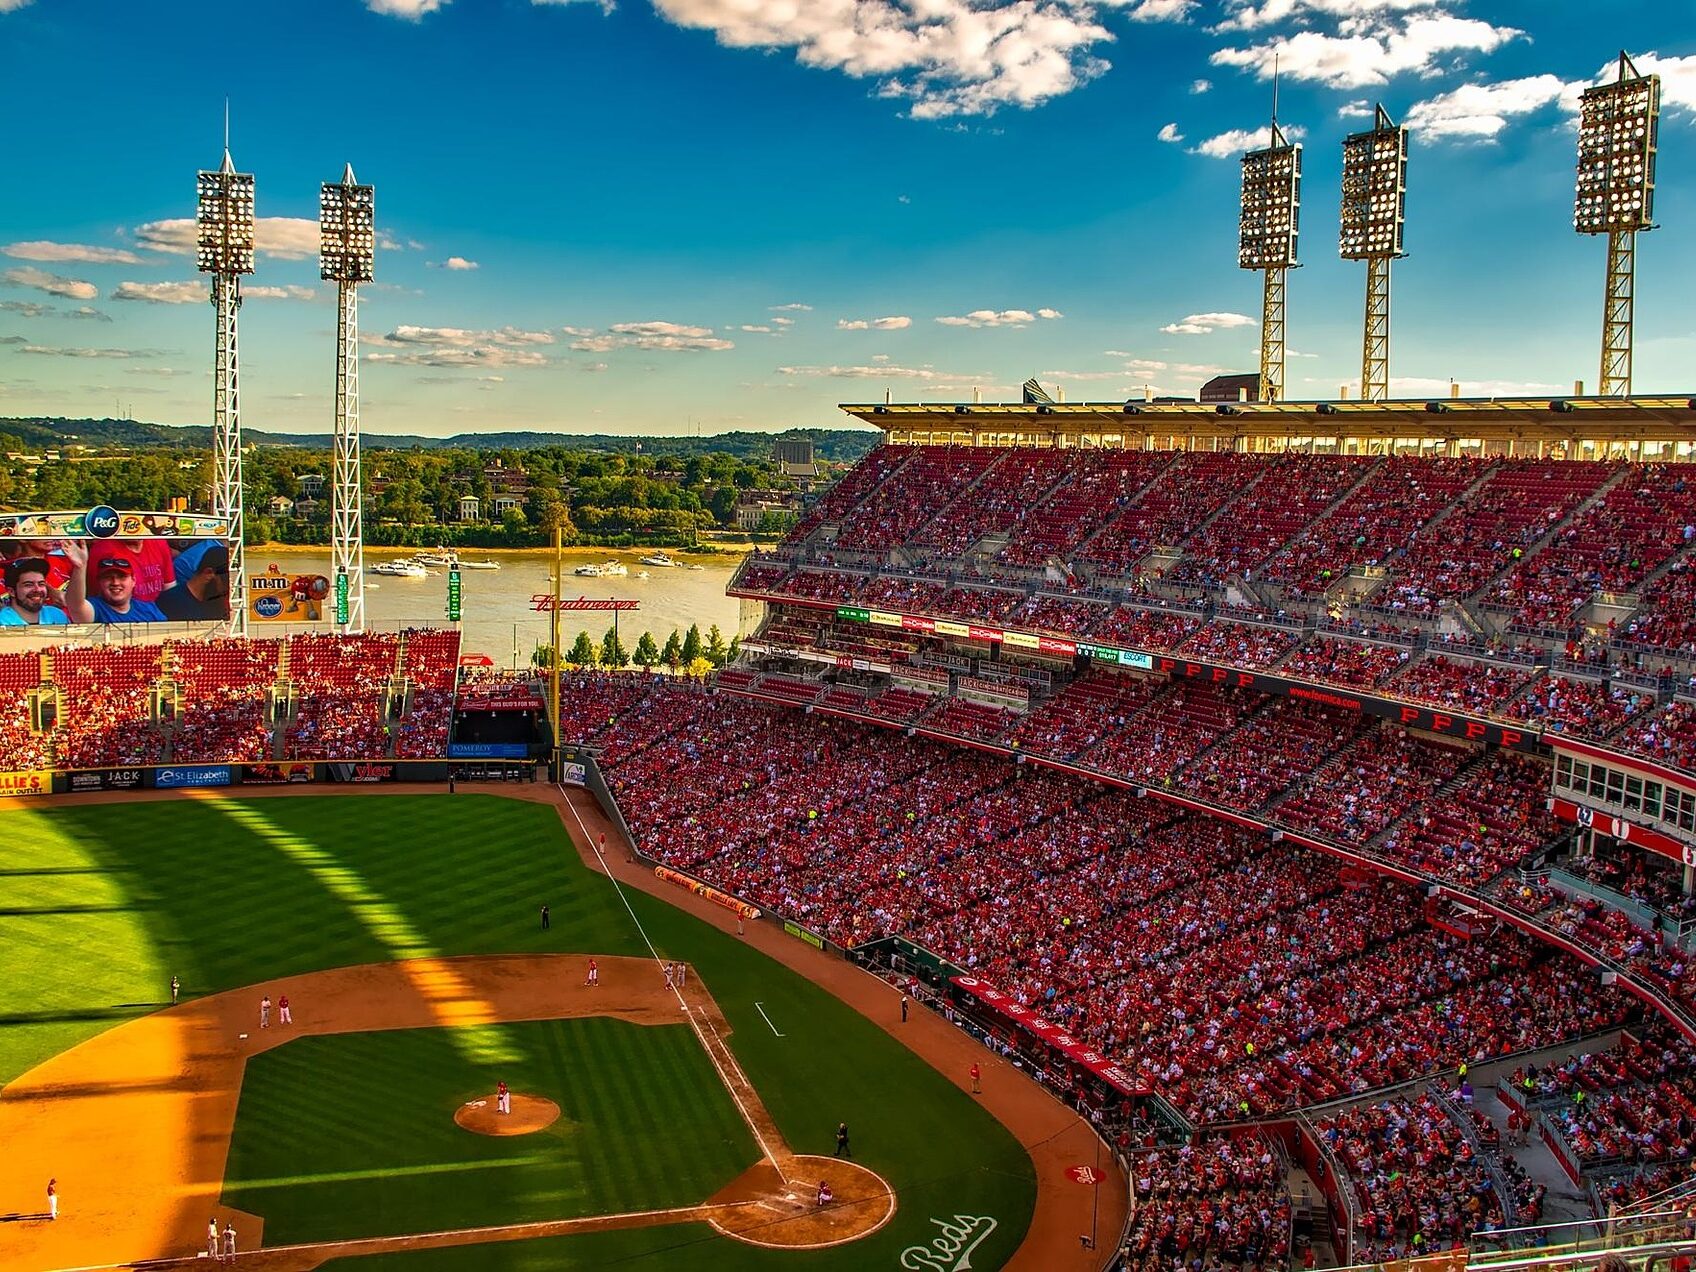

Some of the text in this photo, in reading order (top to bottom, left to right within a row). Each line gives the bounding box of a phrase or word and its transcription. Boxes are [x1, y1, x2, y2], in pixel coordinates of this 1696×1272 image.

[93, 517, 117, 528] P&G
[257, 599, 281, 615] Kroger
[836, 658, 852, 667] JACK
[187, 770, 229, 780] Elizabeth
[900, 1214, 998, 1272] Reds
